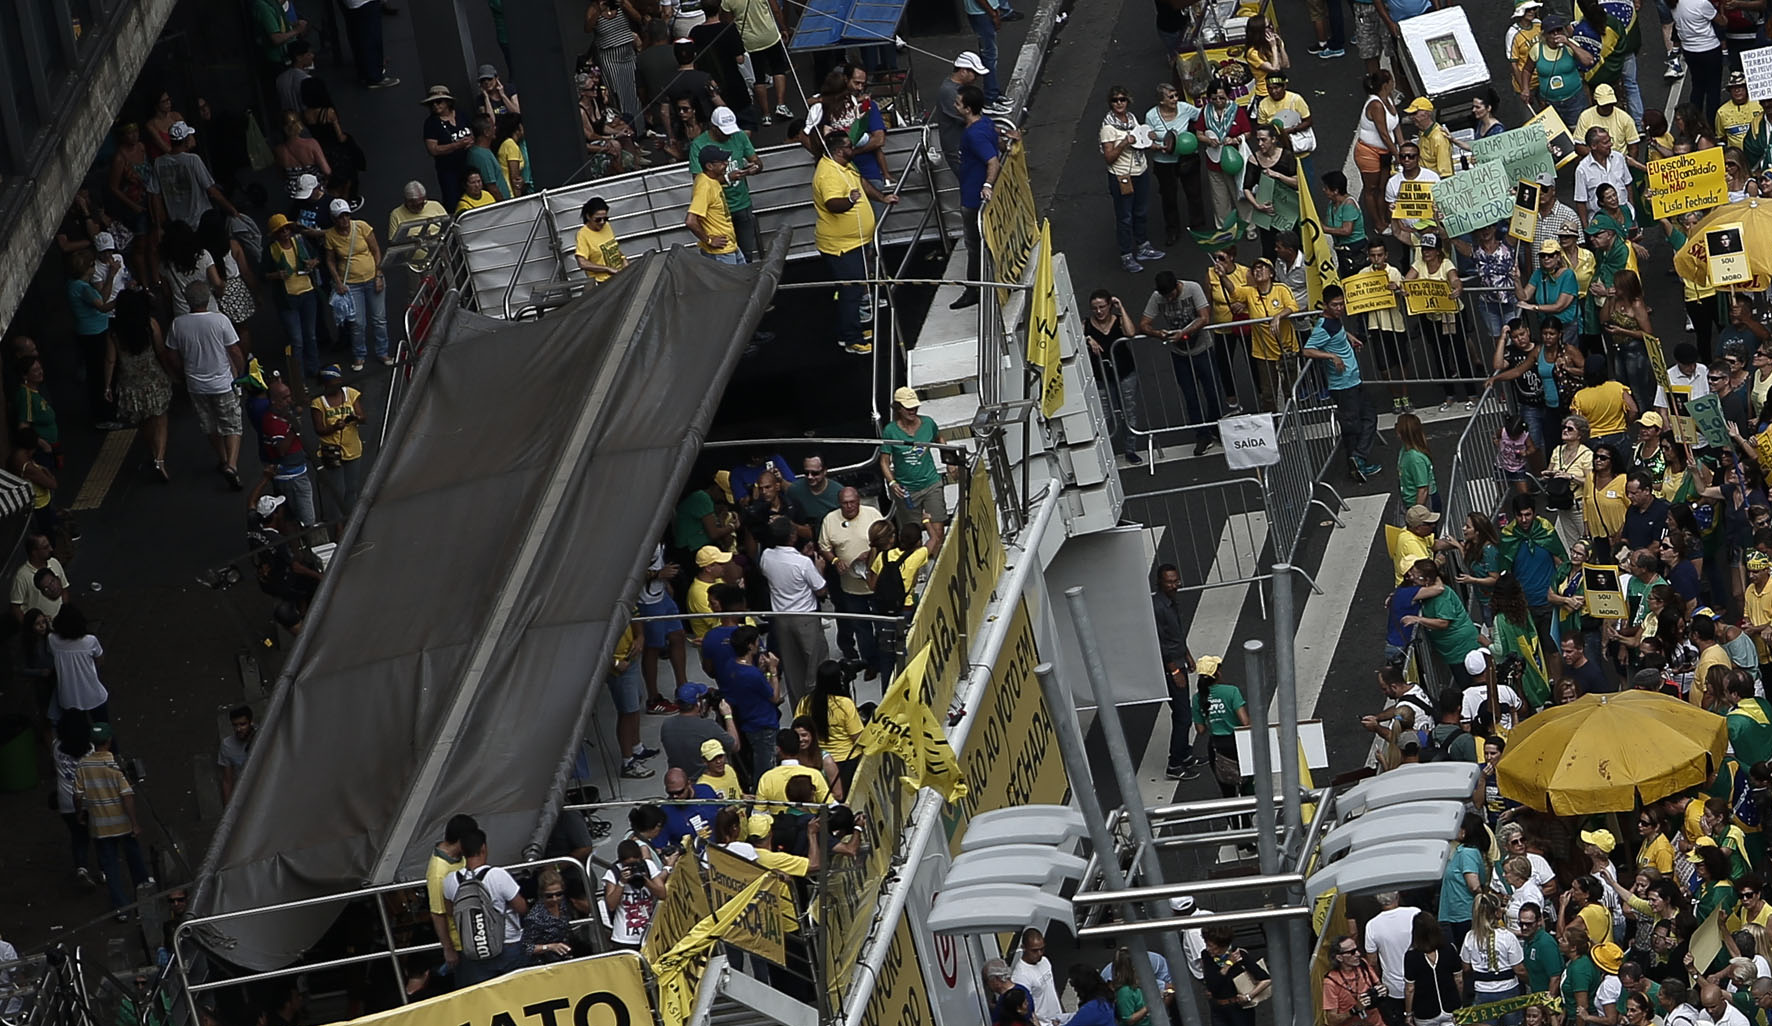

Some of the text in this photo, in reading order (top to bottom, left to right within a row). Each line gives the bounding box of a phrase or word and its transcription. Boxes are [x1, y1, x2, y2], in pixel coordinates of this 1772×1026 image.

[1648, 156, 1696, 176] EU escolho
[1661, 170, 1680, 185] MEU
[1447, 214, 1471, 235] FIM
[1483, 199, 1515, 222] FORO
[1234, 437, 1267, 450] SAÍDA
[473, 911, 492, 959] Wilson
[1470, 1002, 1519, 1023] BRASIL
